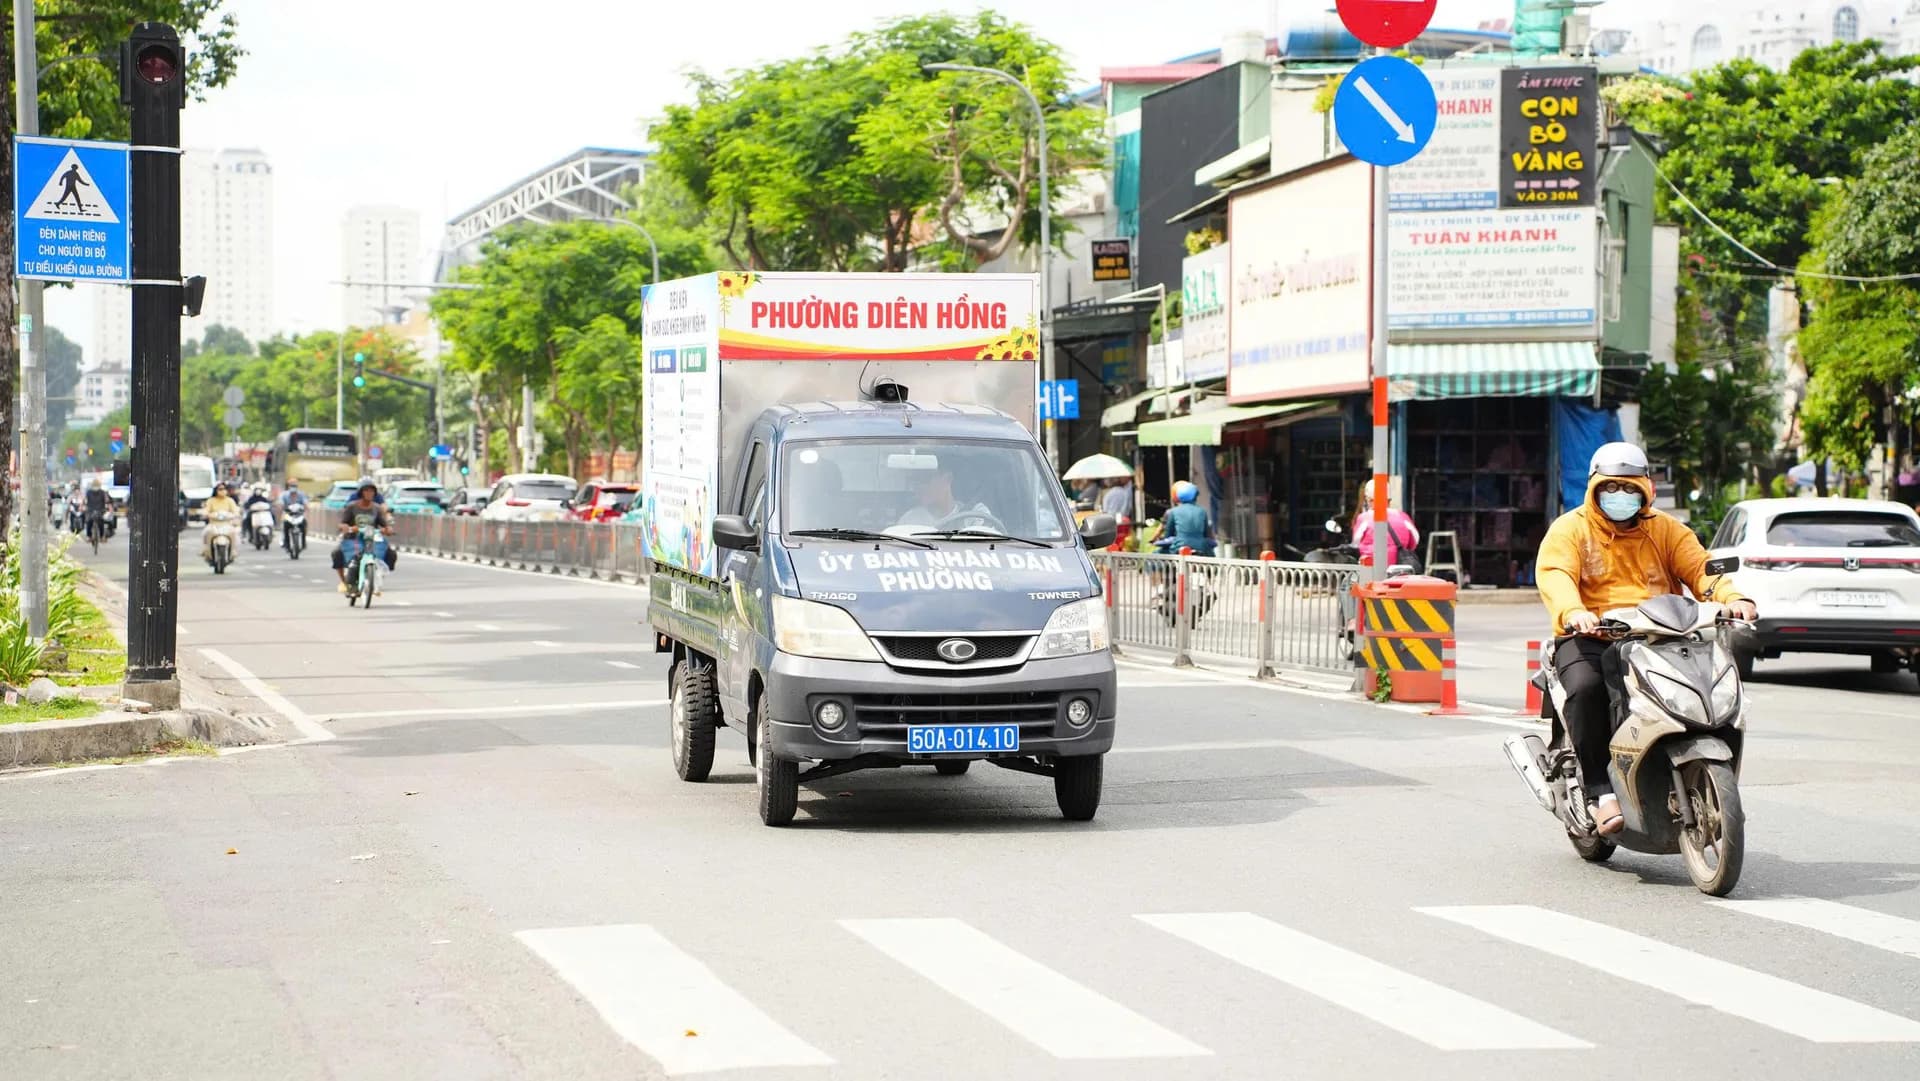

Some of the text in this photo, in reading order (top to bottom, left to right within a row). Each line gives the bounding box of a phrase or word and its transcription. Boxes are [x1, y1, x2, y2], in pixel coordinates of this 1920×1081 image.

[1517, 72, 1584, 91] ẨM THỰC
[1520, 96, 1579, 118] CON
[1529, 118, 1568, 145] BÒ
[1511, 146, 1584, 172] VÀNG
[1516, 189, 1579, 202] VÀO 30M
[58, 226, 81, 241] DÀNH
[82, 228, 107, 243] RIÊNG
[38, 243, 106, 260] CHO NGƯỜI ĐI BỘ
[23, 258, 123, 277] TỰ ĐIỀU KHIỂN QUA ĐƯỜNG
[751, 293, 1007, 329] PHƯỜNG DIÊN HỒNG
[817, 548, 1064, 573] ỦY BAN NHÂN DÂN
[877, 565, 994, 593] PHƯỜNG
[1027, 591, 1081, 600] TOWNER
[912, 727, 1015, 750] 50A-014.10
